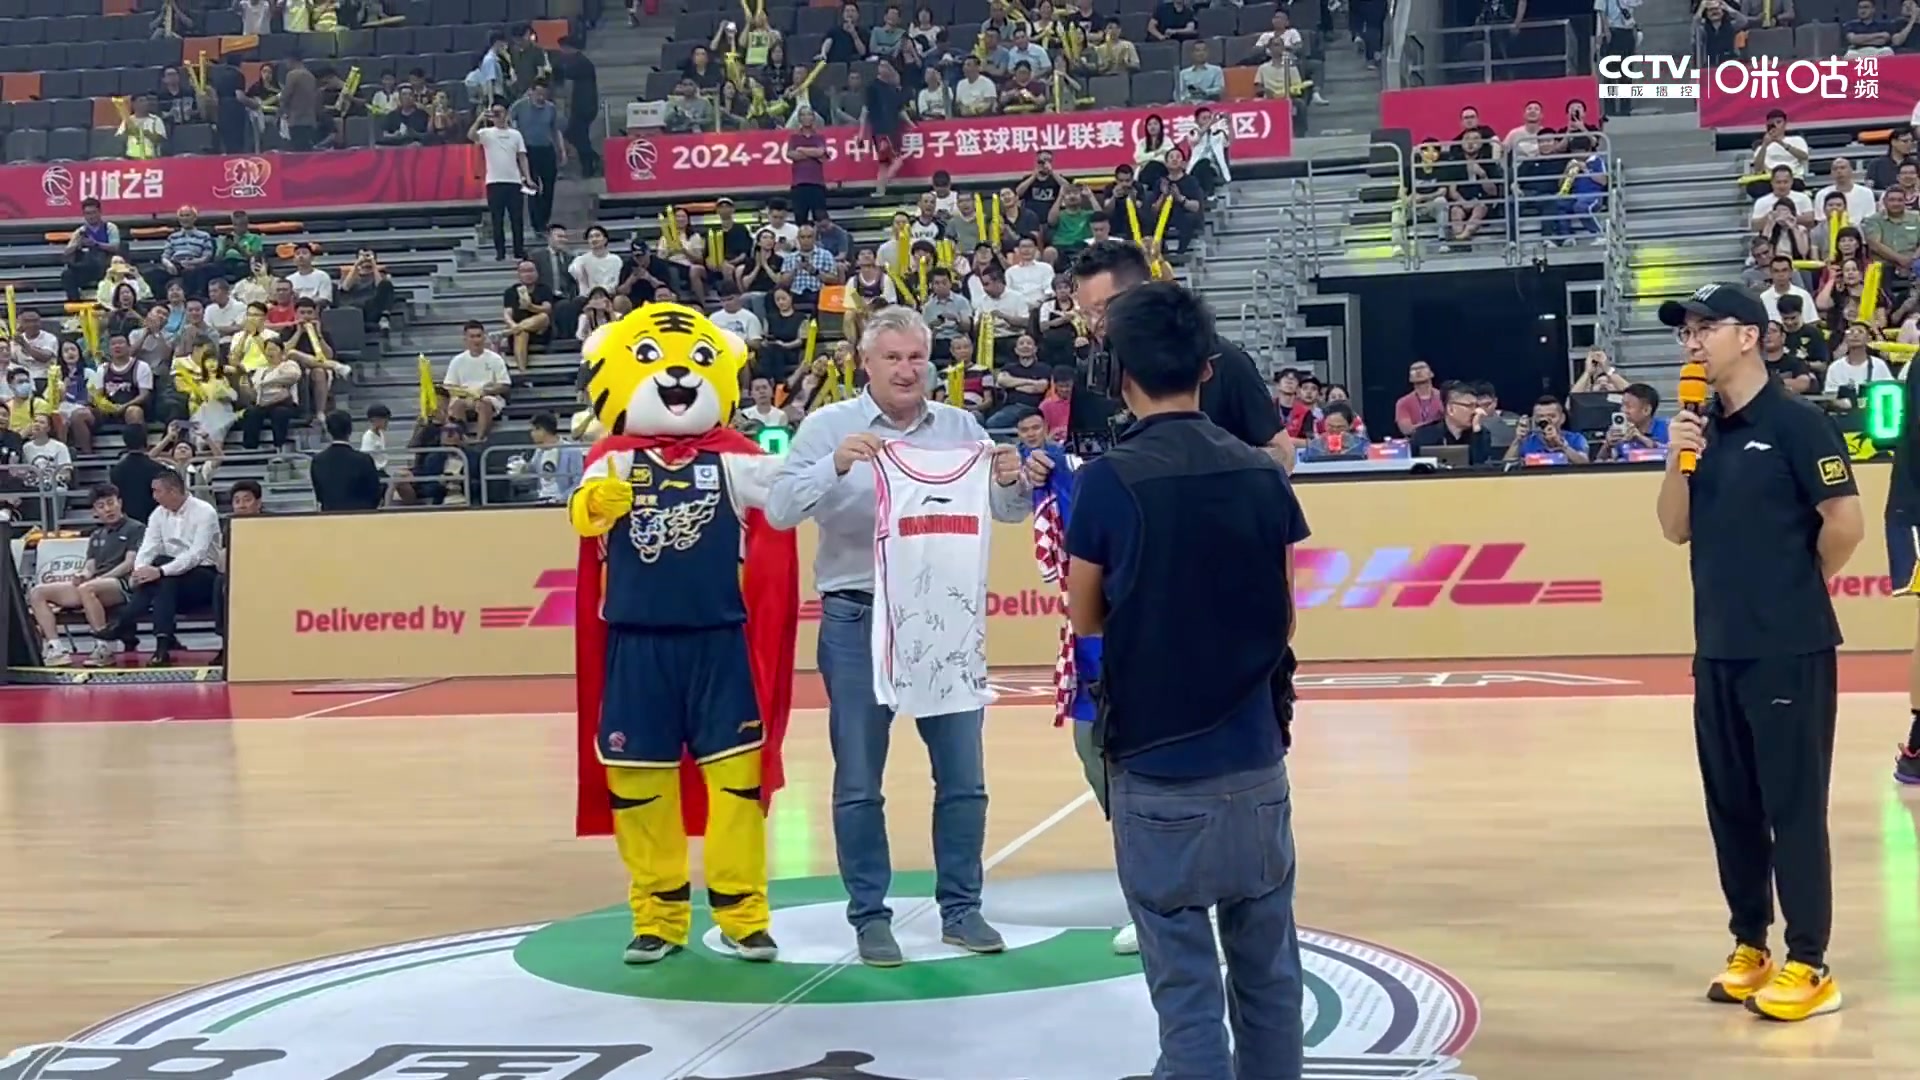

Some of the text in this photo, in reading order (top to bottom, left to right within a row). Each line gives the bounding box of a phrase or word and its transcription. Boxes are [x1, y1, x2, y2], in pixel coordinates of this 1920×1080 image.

[79, 168, 164, 201] 以城之名
[1872, 383, 1903, 439] 0
[296, 606, 466, 634] Delivered by
